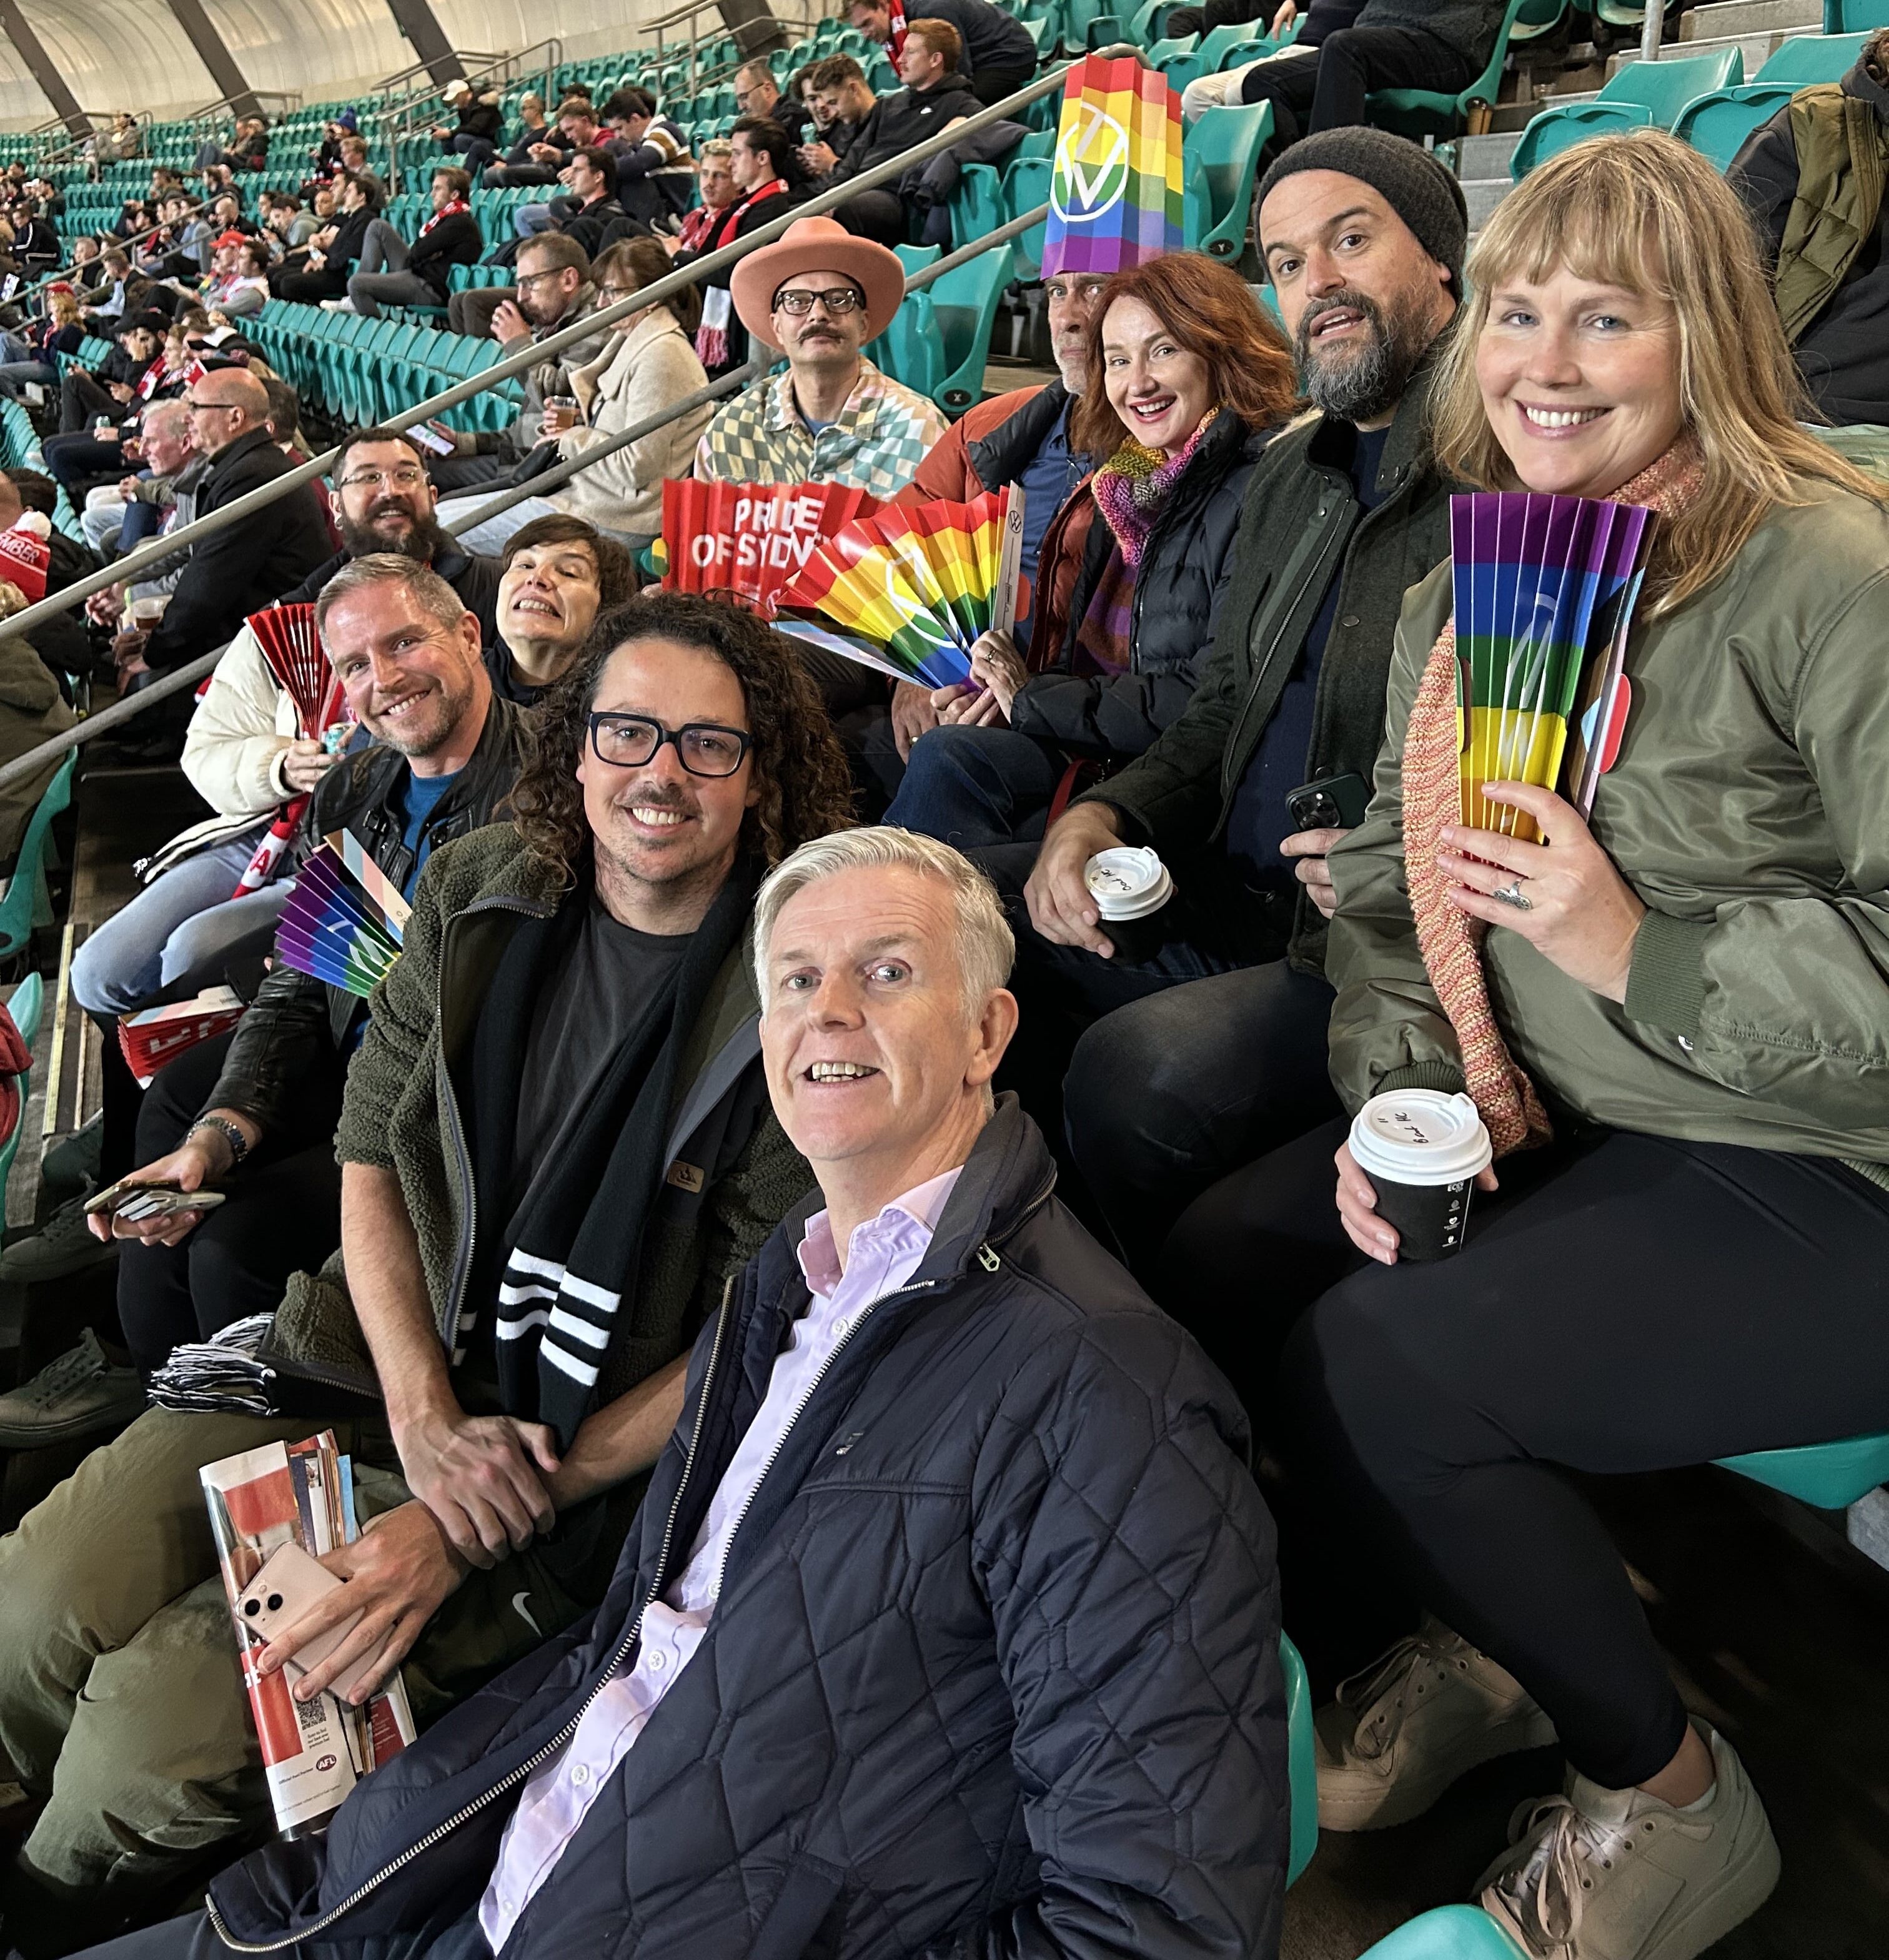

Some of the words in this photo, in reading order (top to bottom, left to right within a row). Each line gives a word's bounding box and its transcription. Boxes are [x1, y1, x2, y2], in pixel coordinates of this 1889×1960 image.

[735, 495, 826, 532] PRIDE
[692, 533, 734, 567] OF
[737, 531, 830, 569] SYDN
[318, 1757, 335, 1769] AFL
